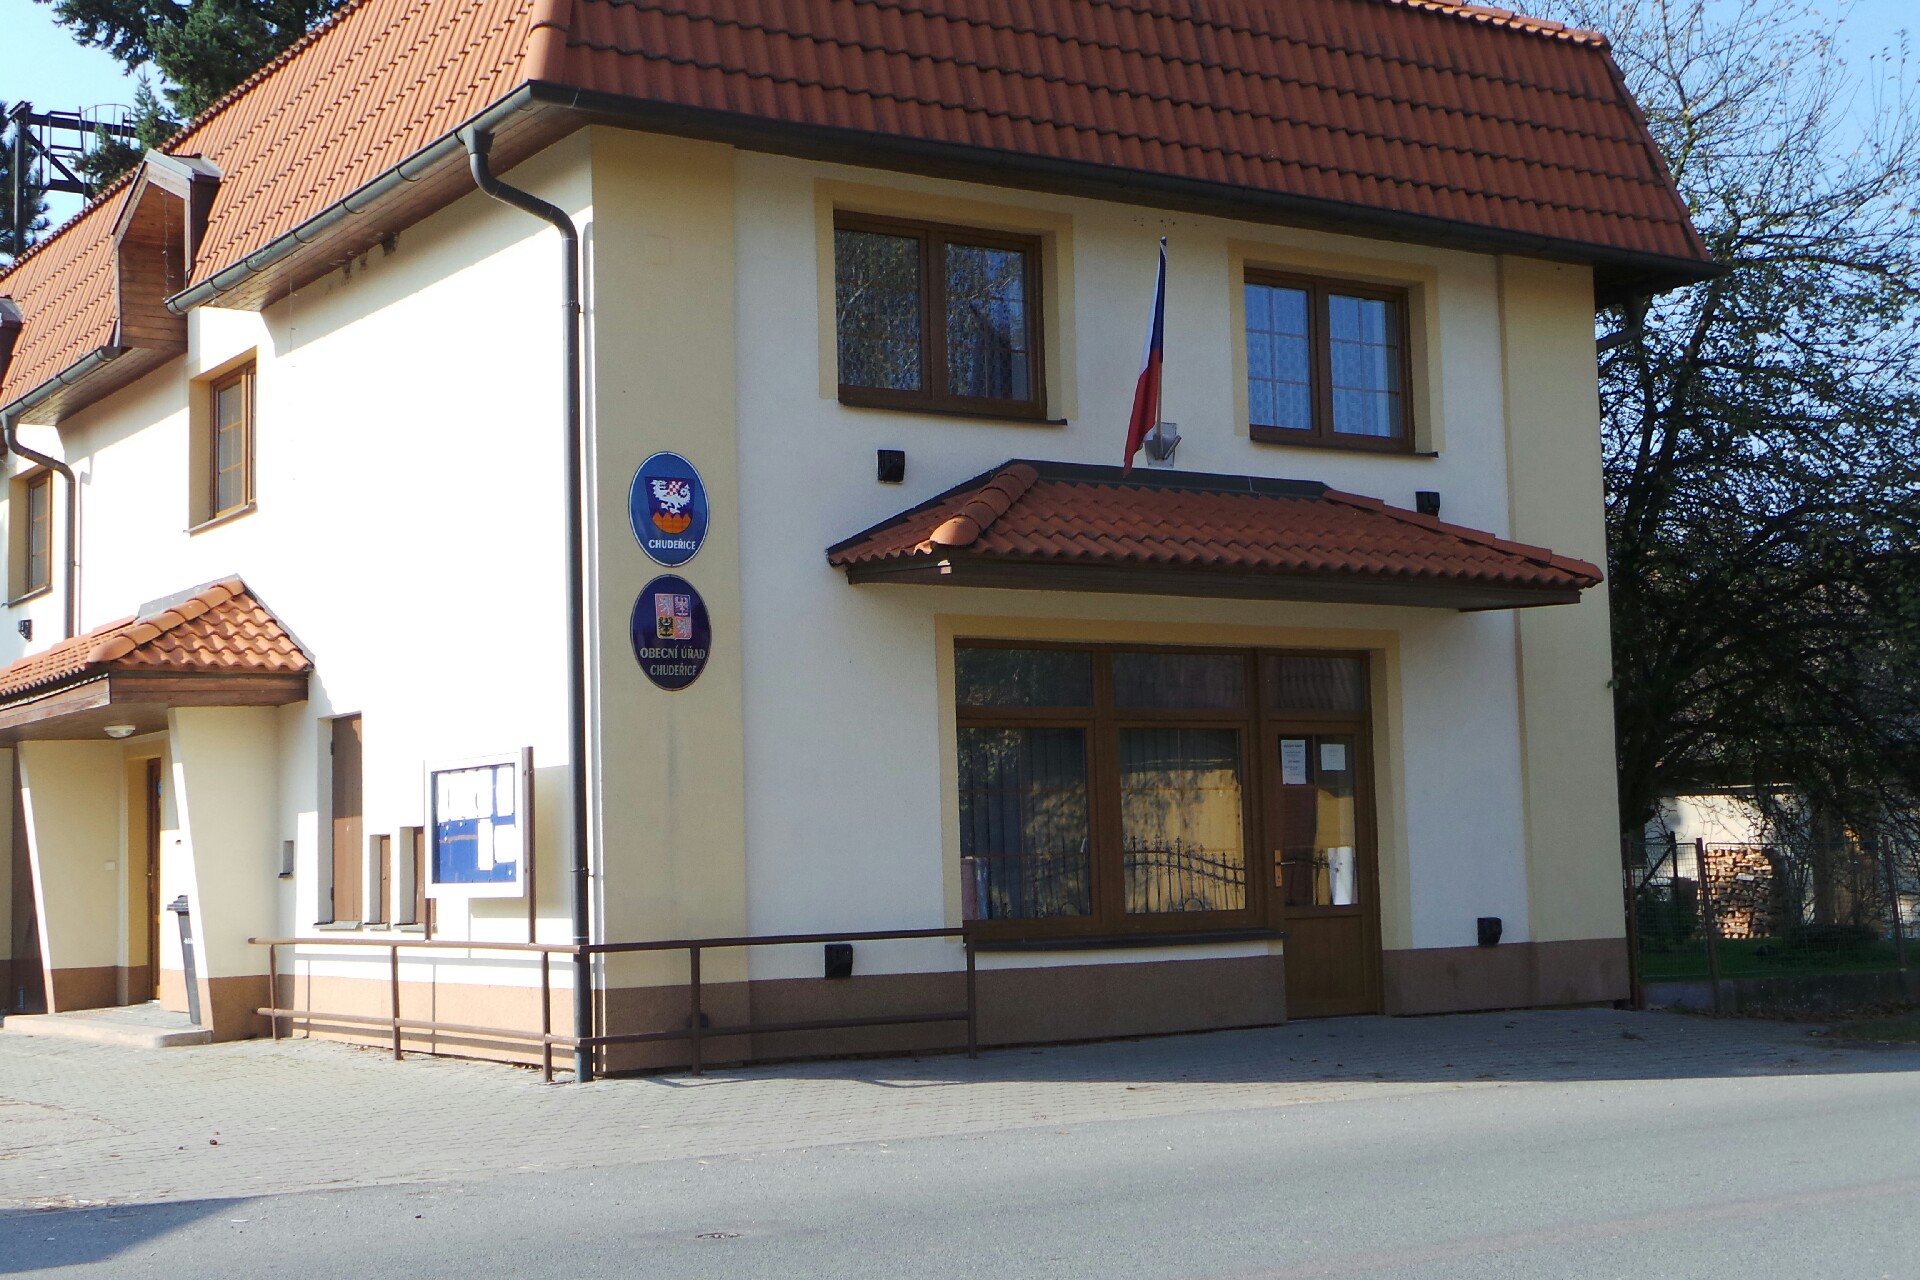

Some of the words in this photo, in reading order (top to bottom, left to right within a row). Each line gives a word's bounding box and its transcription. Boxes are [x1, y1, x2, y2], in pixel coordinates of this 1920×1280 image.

[648, 538, 696, 550] CHUDEŘICE
[640, 645, 679, 659] OBECNÍ
[680, 645, 706, 659] ÚŘAD
[649, 663, 697, 676] CHUDEŘICE
